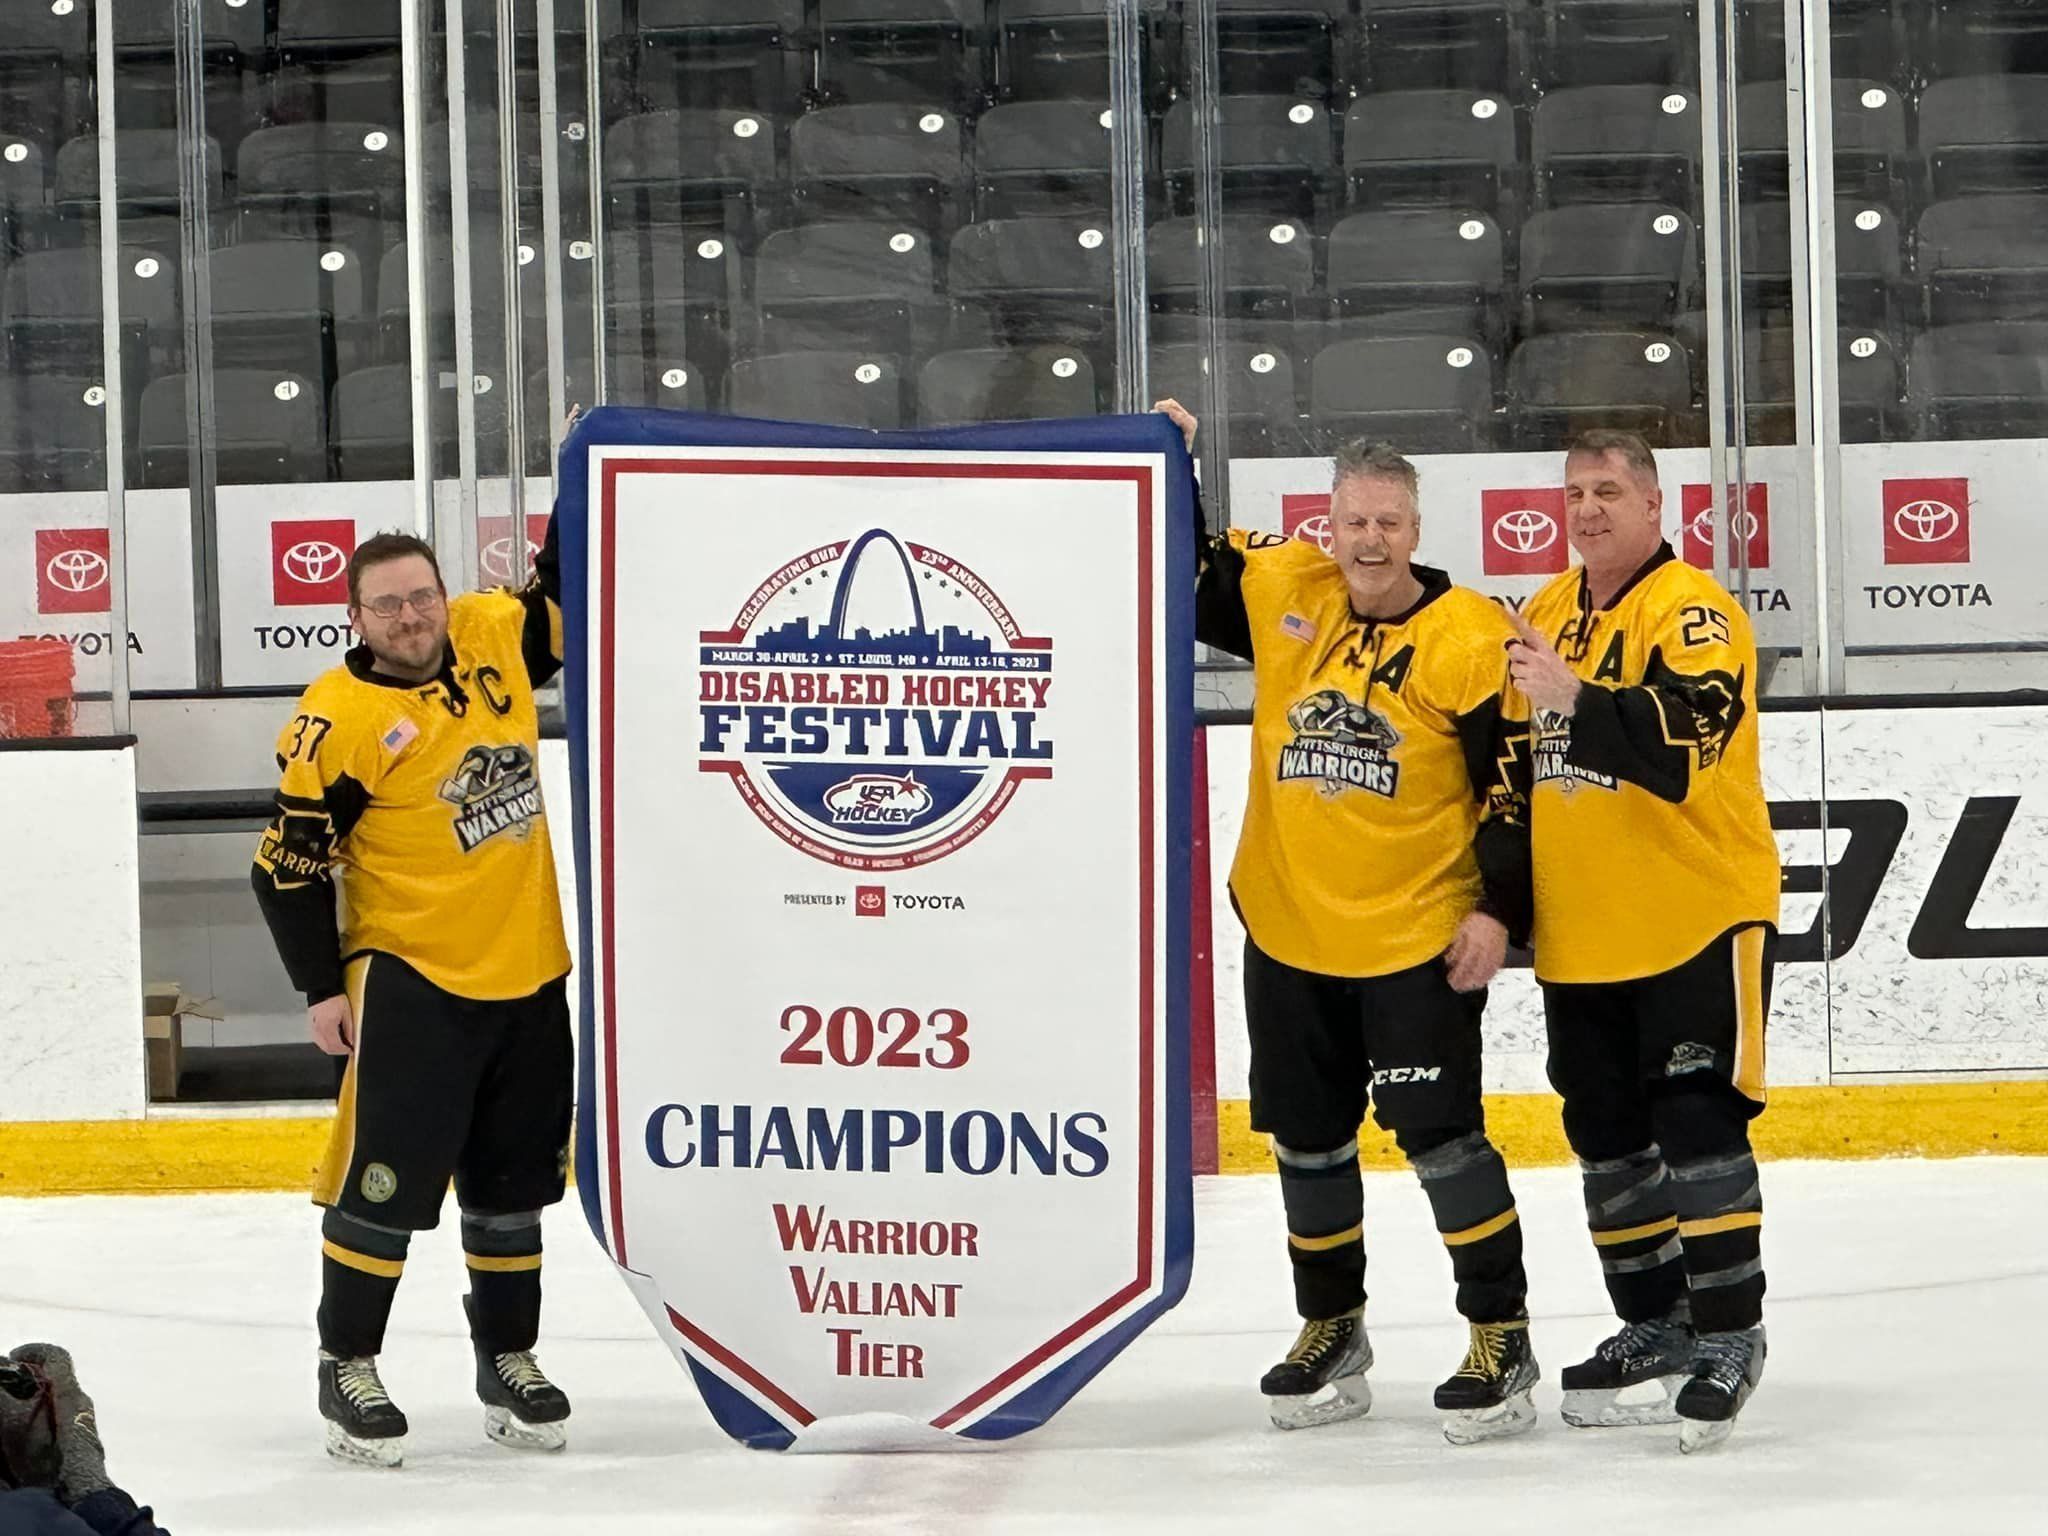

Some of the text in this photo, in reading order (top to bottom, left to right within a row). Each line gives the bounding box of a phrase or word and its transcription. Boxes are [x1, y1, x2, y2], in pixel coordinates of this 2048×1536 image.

[810, 546, 839, 565] OUR
[948, 565, 1020, 640] ANNIVERSARY
[1863, 583, 1993, 609] TOYOTA
[253, 624, 353, 649] TOYOT
[1680, 605, 1730, 647] 25
[712, 651, 753, 663] MARCH
[936, 655, 970, 667] APRIL
[1370, 643, 1416, 694] A
[1593, 629, 1626, 683] A
[477, 665, 512, 716] C
[699, 671, 1052, 708] DISABLED HOCKEY
[288, 714, 333, 763] 37
[699, 705, 1053, 759] FESTIVAL
[1281, 748, 1393, 795] WARRIORS
[835, 804, 915, 822] HOCKEY
[860, 785, 895, 803] USA
[784, 894, 966, 910] PRESENTED BY TOYOTA
[779, 1004, 970, 1069] 2023
[1373, 1066, 1441, 1085] CCM
[645, 1103, 1109, 1178] CHAMPIONS
